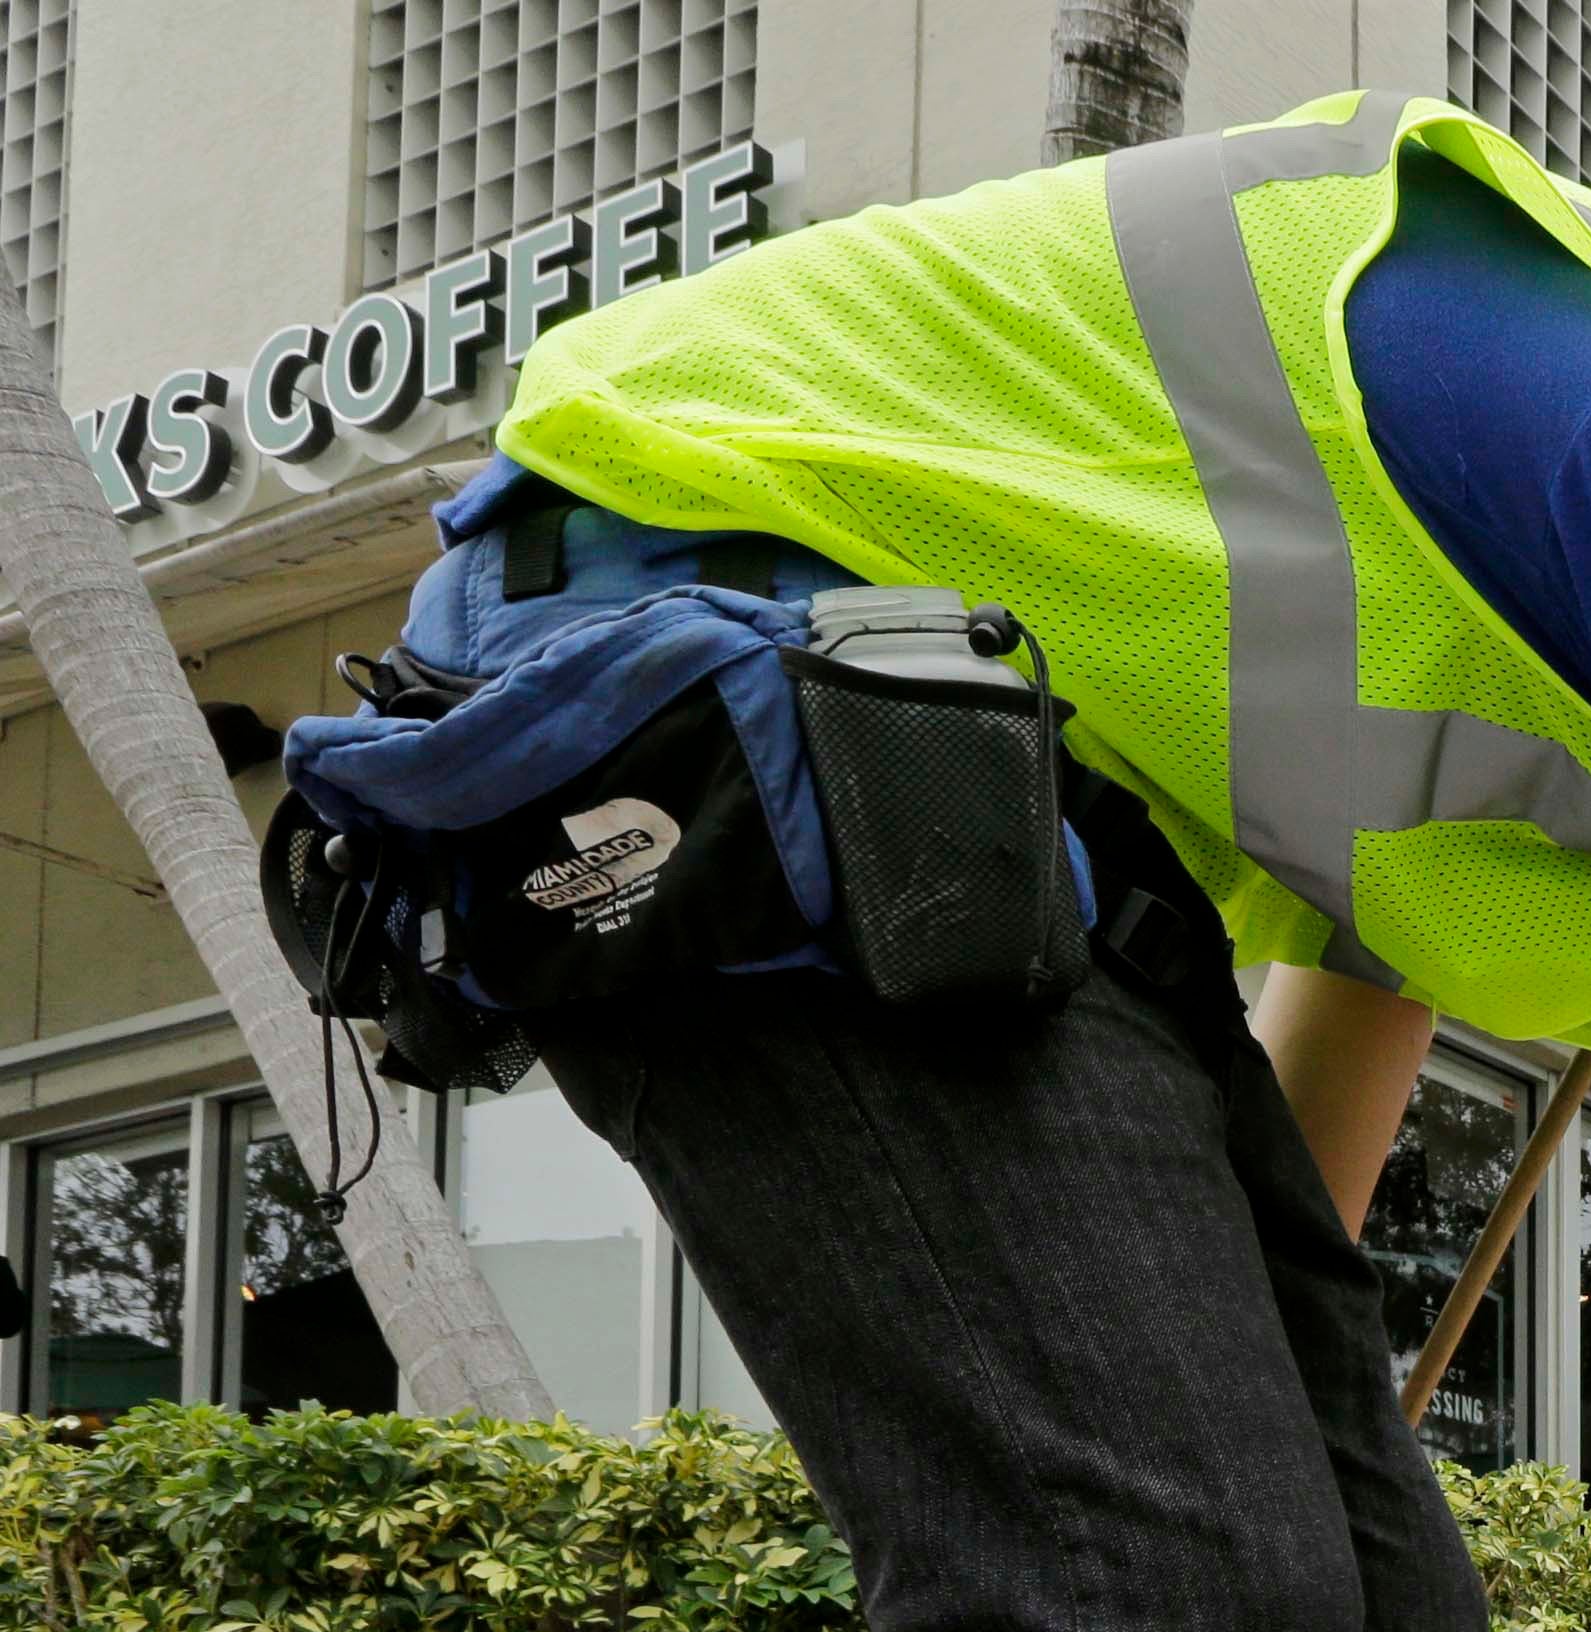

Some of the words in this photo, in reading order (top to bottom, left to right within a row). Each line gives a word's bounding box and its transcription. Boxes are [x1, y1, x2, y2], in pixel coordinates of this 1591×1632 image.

[243, 139, 770, 458] COFFEE
[536, 871, 608, 907] COUNTY
[1423, 1388, 1484, 1424] SSING
